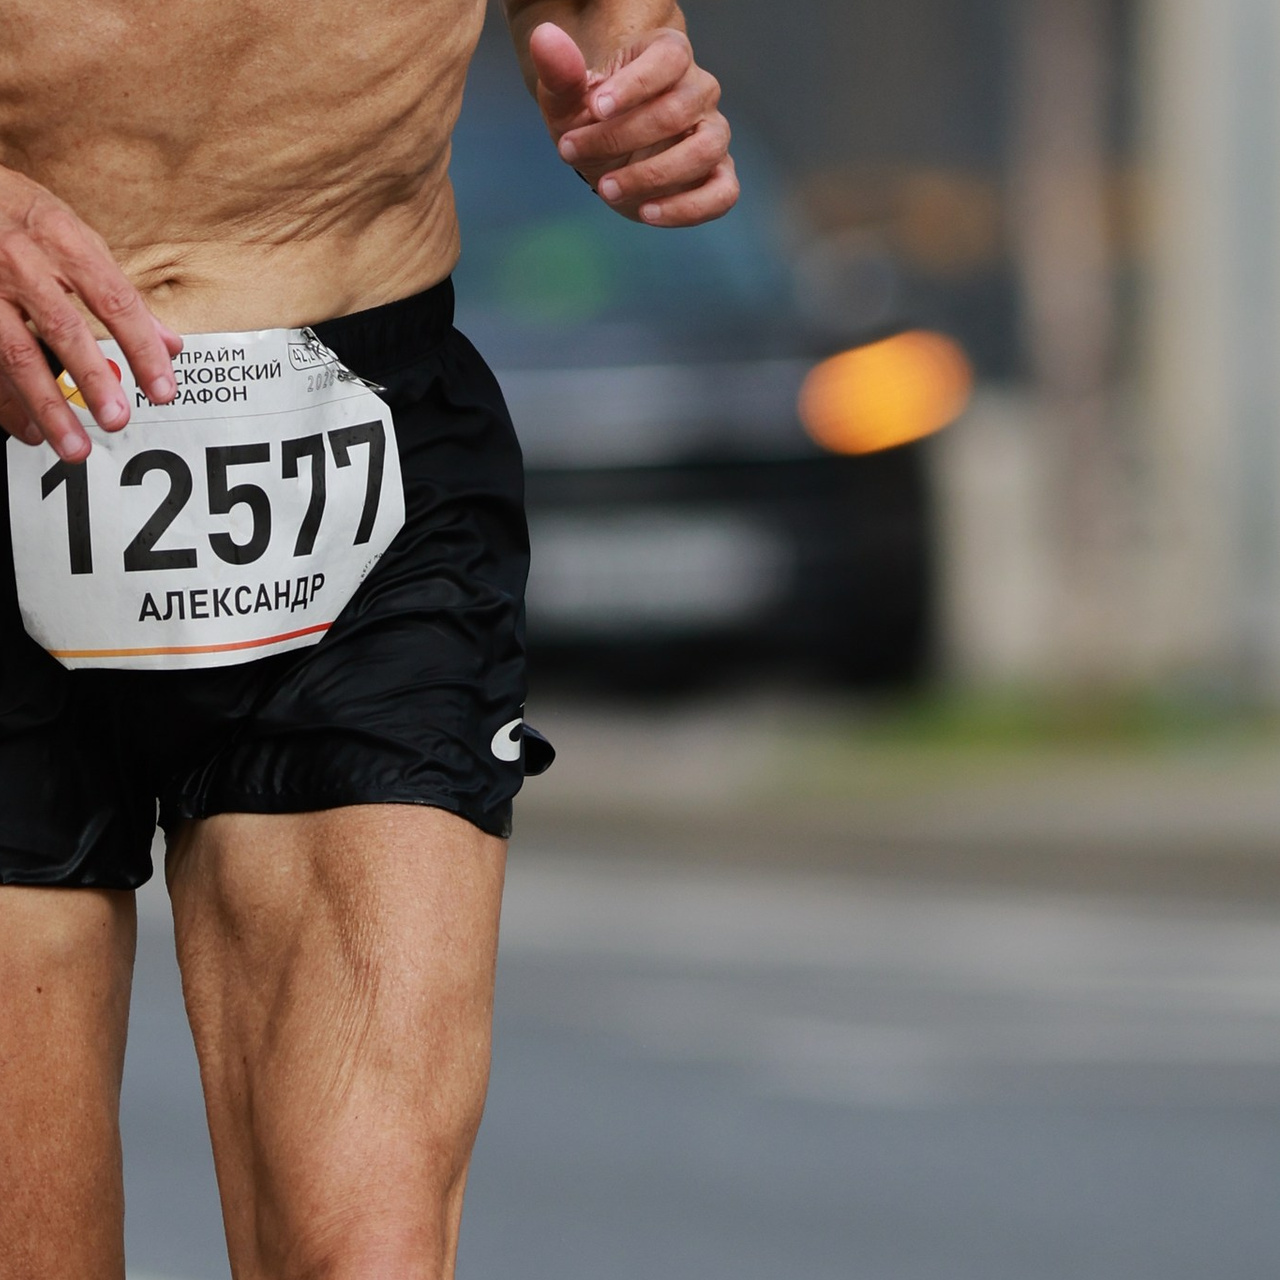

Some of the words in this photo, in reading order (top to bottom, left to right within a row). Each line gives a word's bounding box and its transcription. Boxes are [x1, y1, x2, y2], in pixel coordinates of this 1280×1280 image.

[135, 359, 282, 388] СКОВСКИЙ
[136, 385, 248, 408] МРАФОН
[40, 419, 386, 575] 12577
[138, 573, 326, 622] АЛЕКСАНДР
